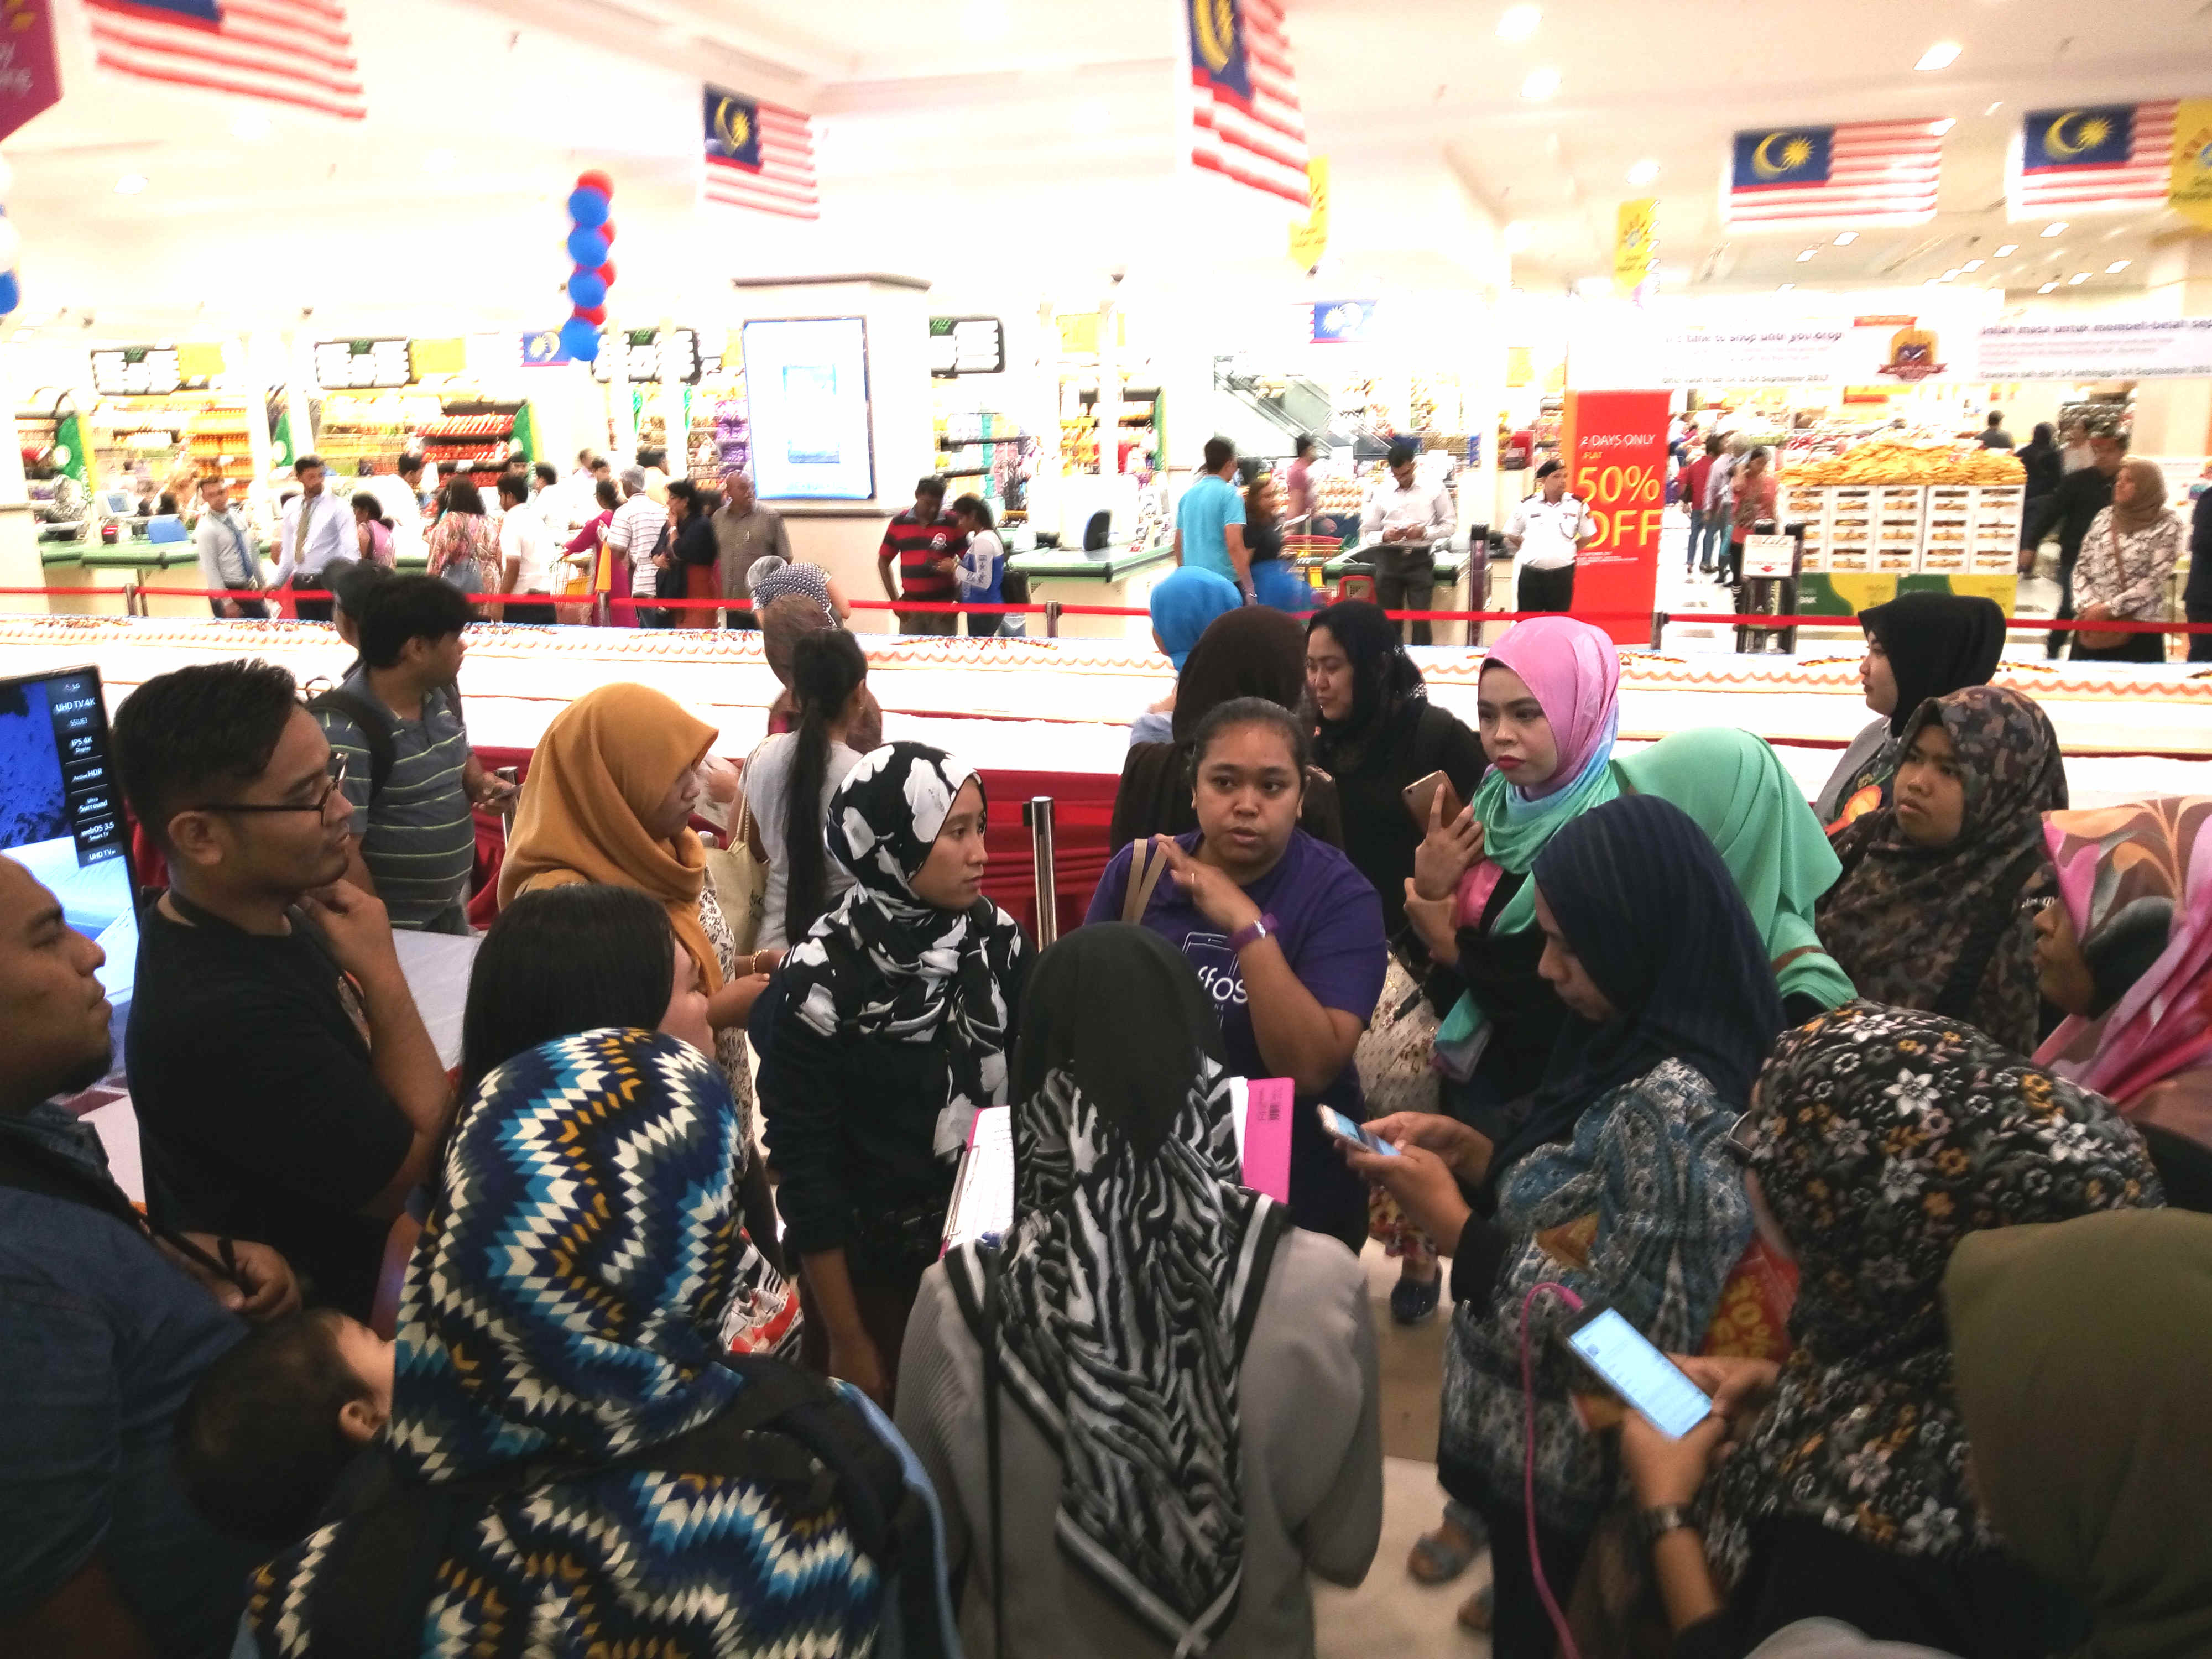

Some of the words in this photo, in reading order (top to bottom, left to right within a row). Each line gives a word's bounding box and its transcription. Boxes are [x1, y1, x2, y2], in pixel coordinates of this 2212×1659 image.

[1580, 436, 1589, 446] 2
[1592, 434, 1622, 446] DAYS
[1623, 434, 1656, 446] ONLY
[1577, 465, 1660, 504] 50%
[56, 701, 73, 712] UHD
[73, 699, 84, 708] TV
[84, 697, 96, 707] 4K
[71, 738, 83, 747] IPS
[84, 735, 93, 744] 4K
[79, 799, 108, 813] Surround
[81, 824, 103, 836] webOS
[104, 821, 115, 830] 3.5
[88, 851, 103, 860] UHD
